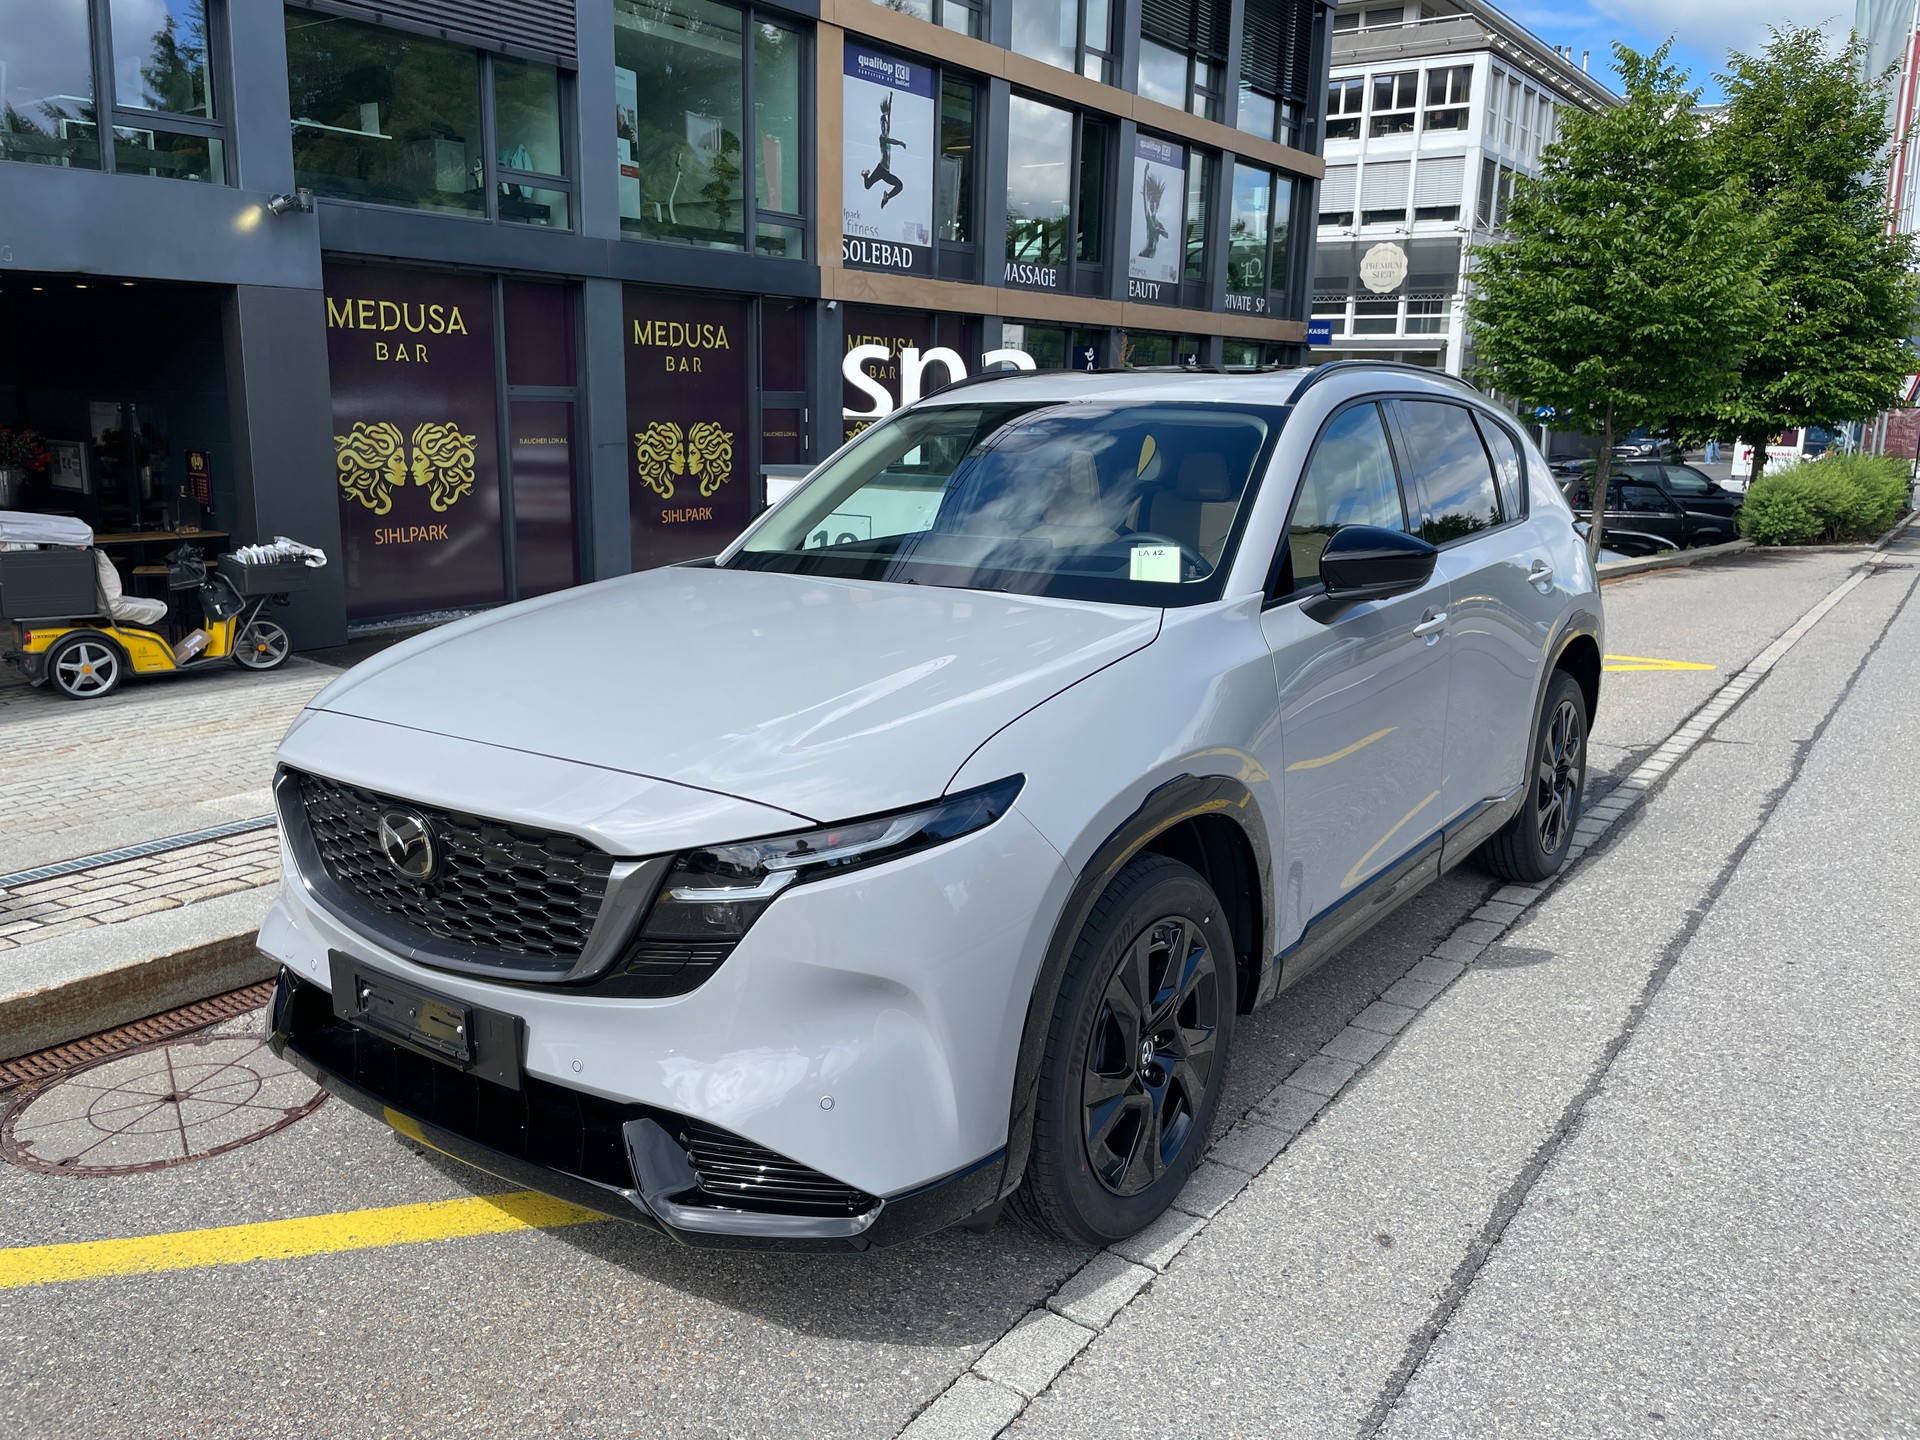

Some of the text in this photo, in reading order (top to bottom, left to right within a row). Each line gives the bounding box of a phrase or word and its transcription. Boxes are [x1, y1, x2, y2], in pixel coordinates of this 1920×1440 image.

[858, 55, 894, 74] qualitop
[847, 219, 879, 237] fitness
[842, 238, 913, 268] SOLEBAD
[1365, 261, 1403, 270] PREMIUM
[326, 297, 468, 335] MEDUSA
[633, 319, 730, 350] MEDUSA
[375, 342, 429, 363] BAR
[665, 355, 703, 373] BAR
[869, 365, 896, 379] BAR
[661, 507, 713, 524] SIHLPARK
[374, 524, 449, 545] SIHLPARK
